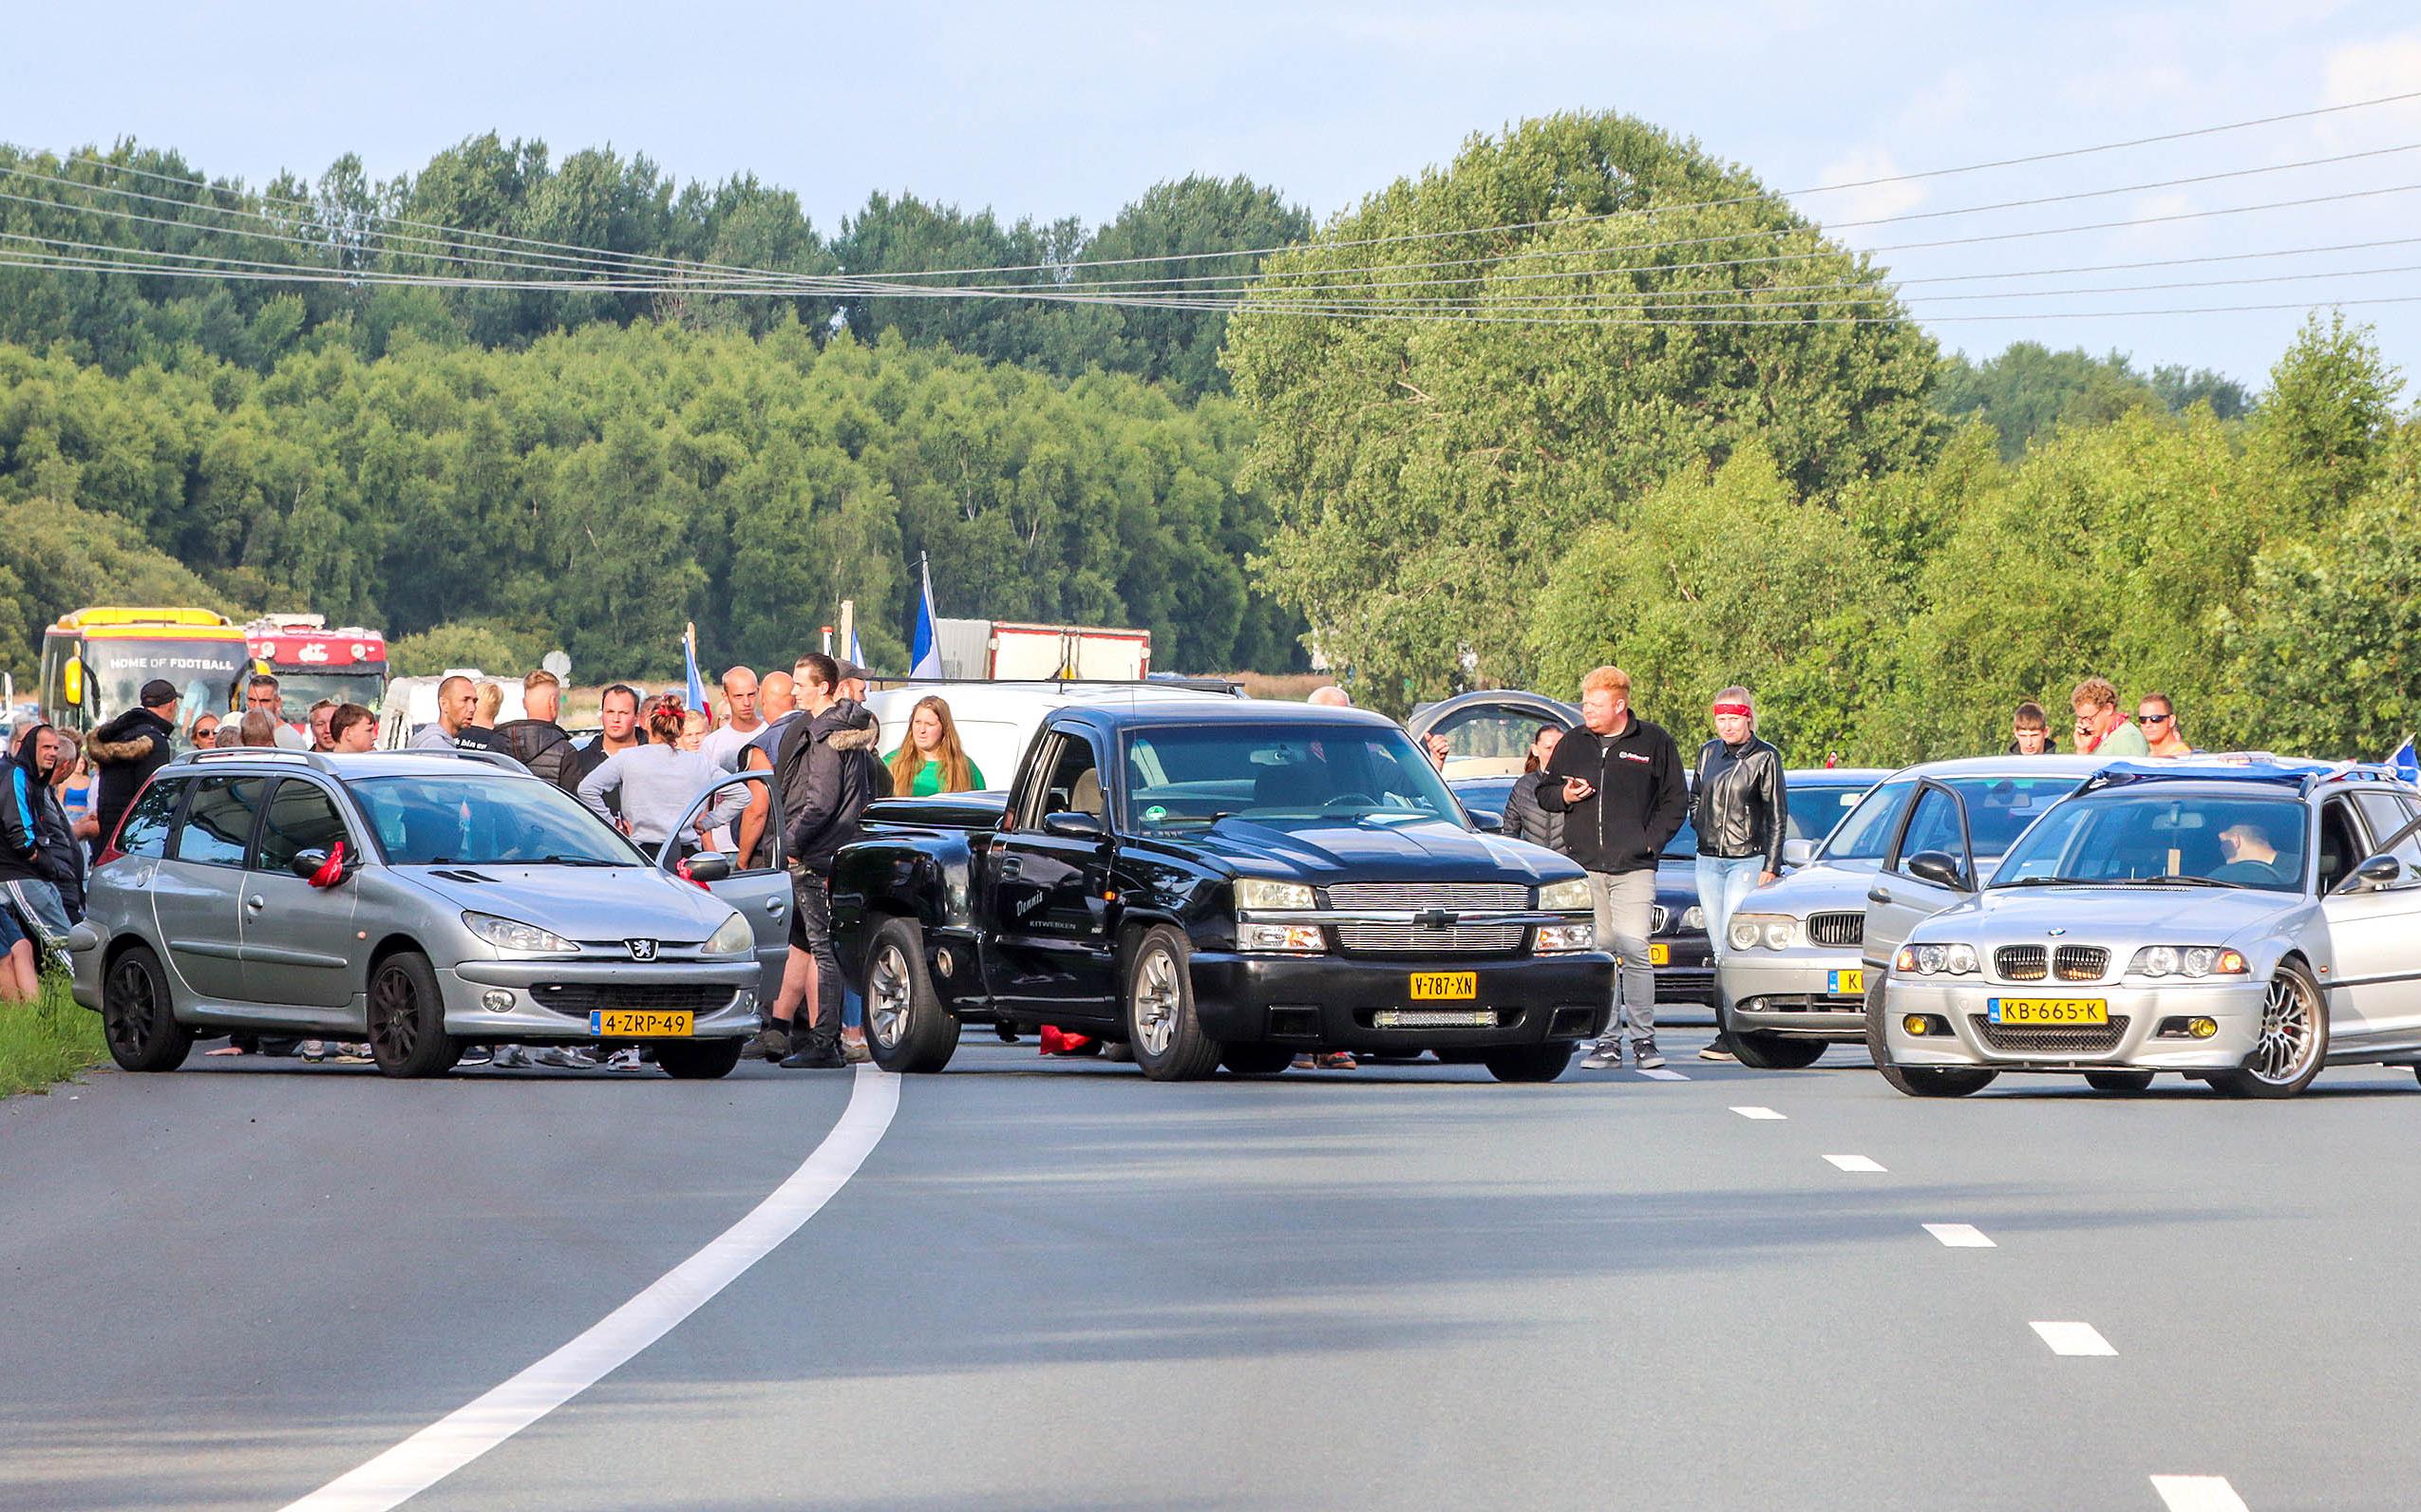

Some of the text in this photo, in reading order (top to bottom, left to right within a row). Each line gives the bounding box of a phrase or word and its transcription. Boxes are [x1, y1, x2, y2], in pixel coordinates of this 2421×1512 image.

[110, 658, 235, 671] HOME OF FOOTBALL
[1016, 889, 1043, 917] Dennis
[1415, 976, 1472, 995] V-787-XN
[2005, 1002, 2098, 1019] KB-665-K
[606, 1014, 685, 1032] 4-ZRP-49
